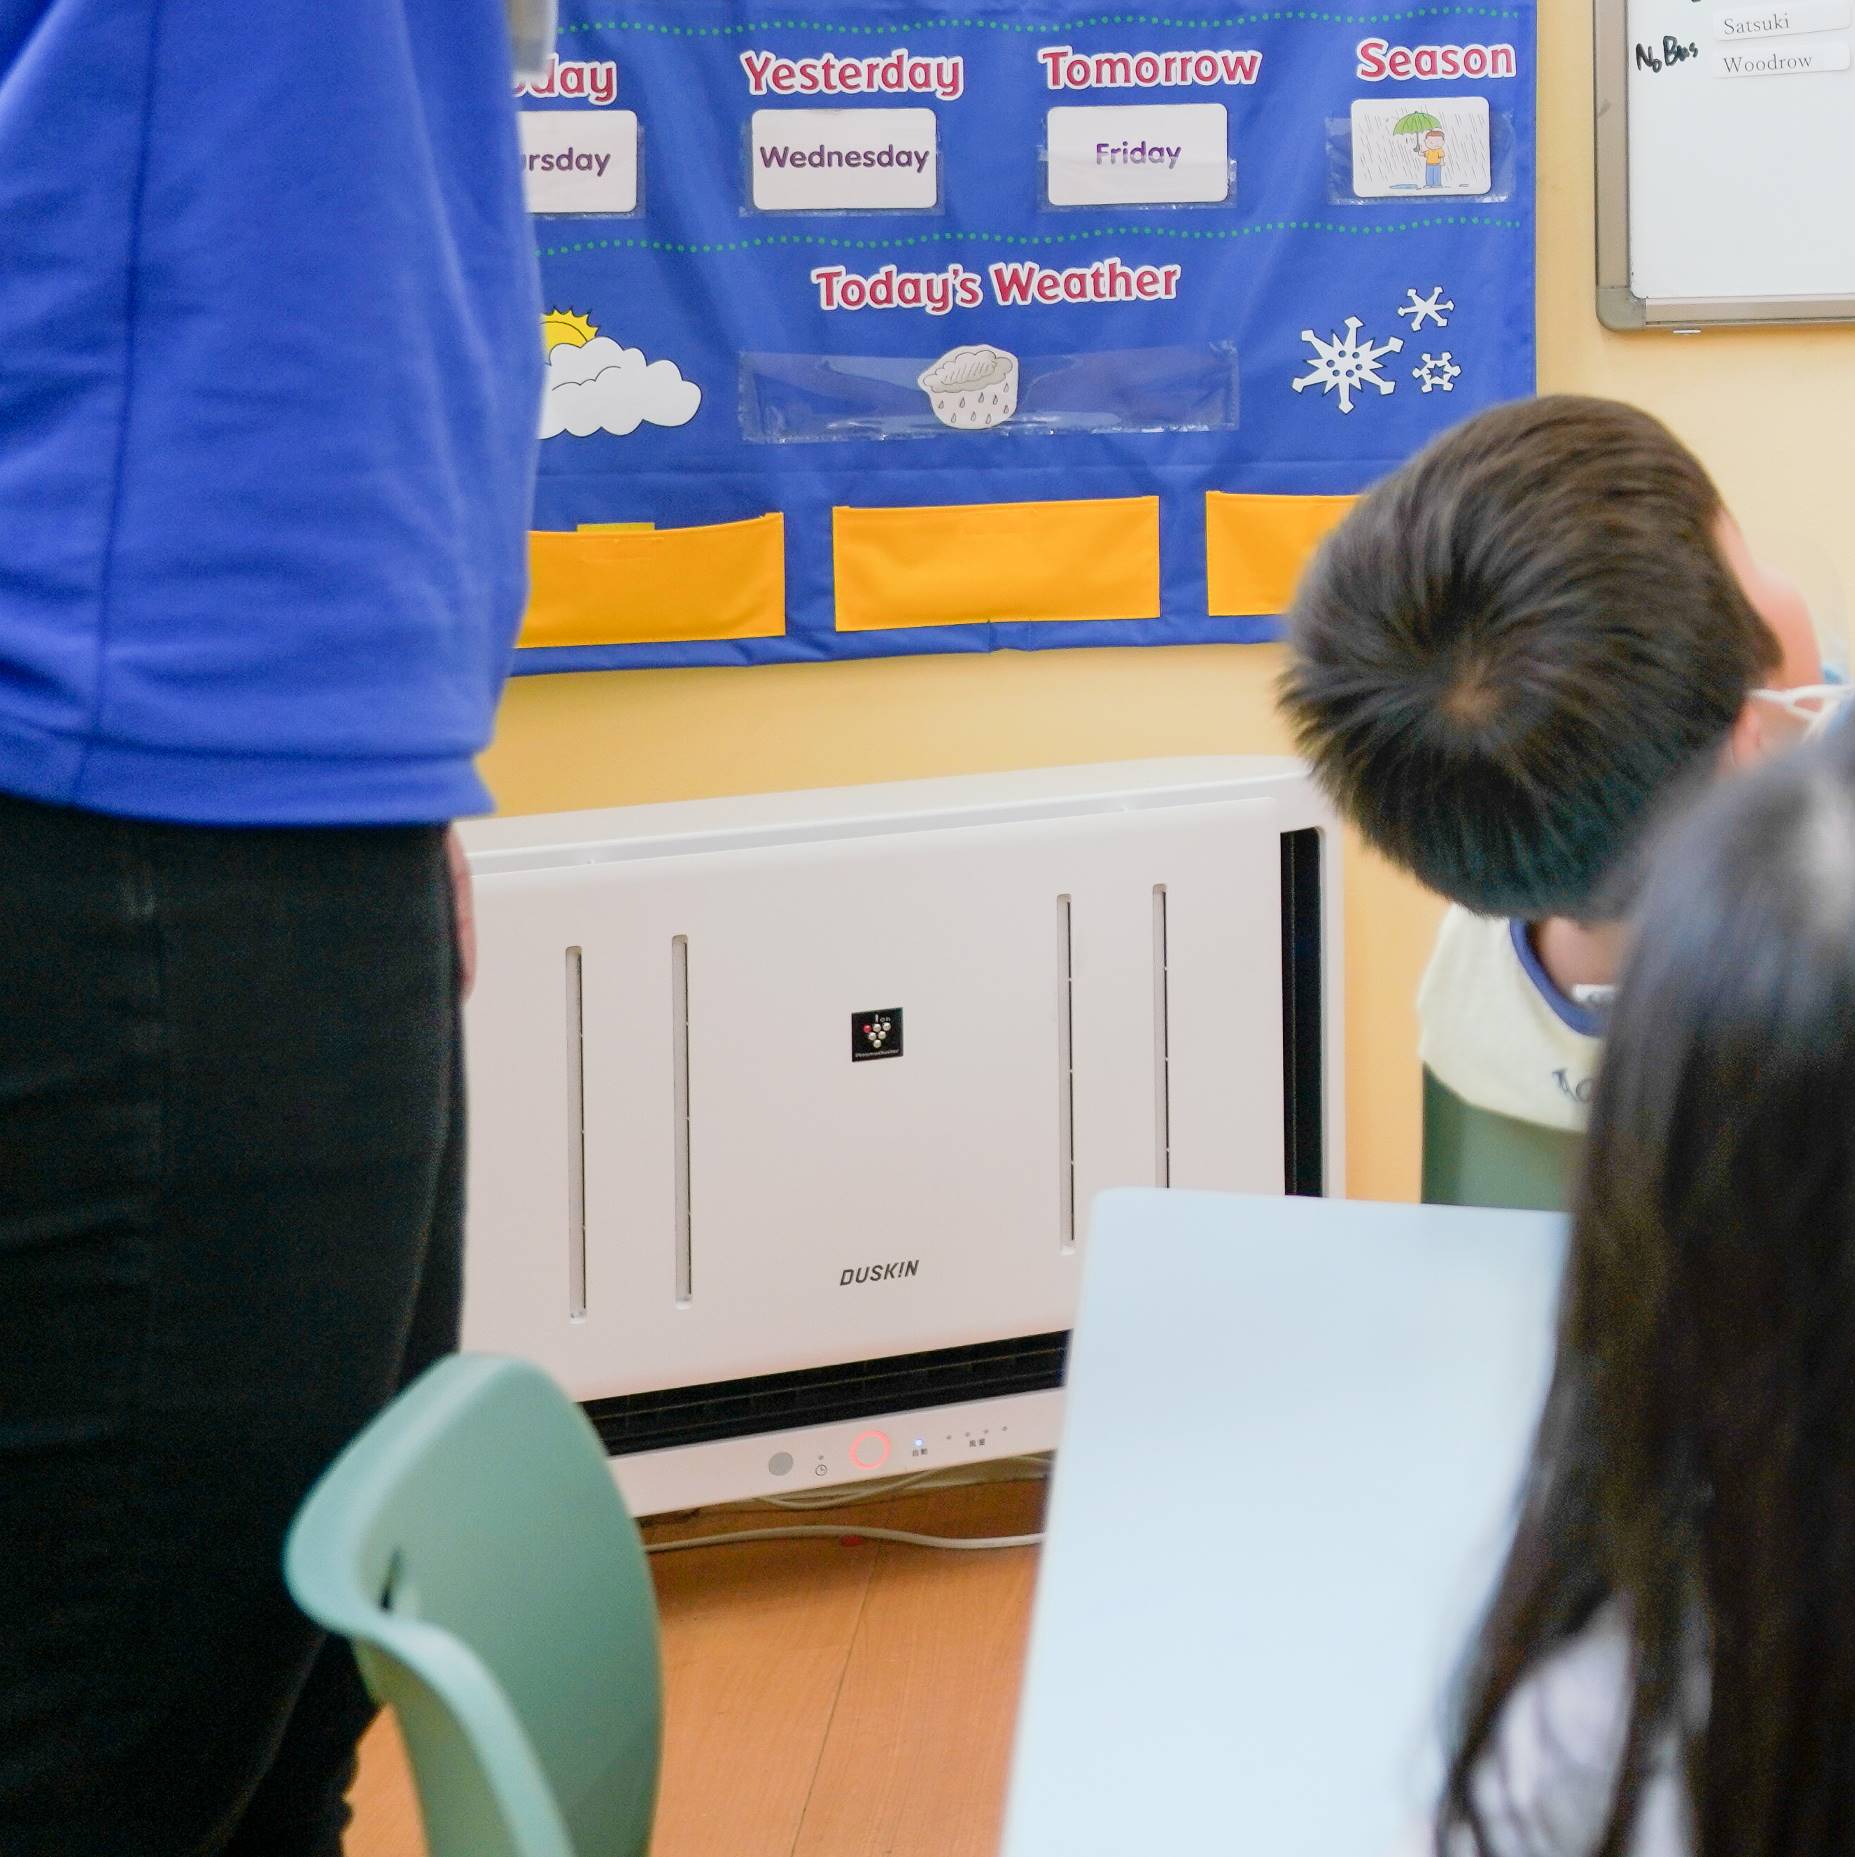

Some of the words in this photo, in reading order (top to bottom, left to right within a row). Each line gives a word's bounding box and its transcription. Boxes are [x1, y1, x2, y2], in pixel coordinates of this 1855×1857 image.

[1723, 12, 1791, 36] Satsuki
[744, 50, 962, 99] Yesterday
[1041, 48, 1260, 88] Tomorrow
[1358, 41, 1515, 79] Season
[1722, 54, 1813, 74] Woodrow
[759, 144, 931, 174] Wednesday
[1095, 142, 1183, 170] Friday
[815, 268, 981, 314] Today's
[994, 260, 1180, 304] Weather
